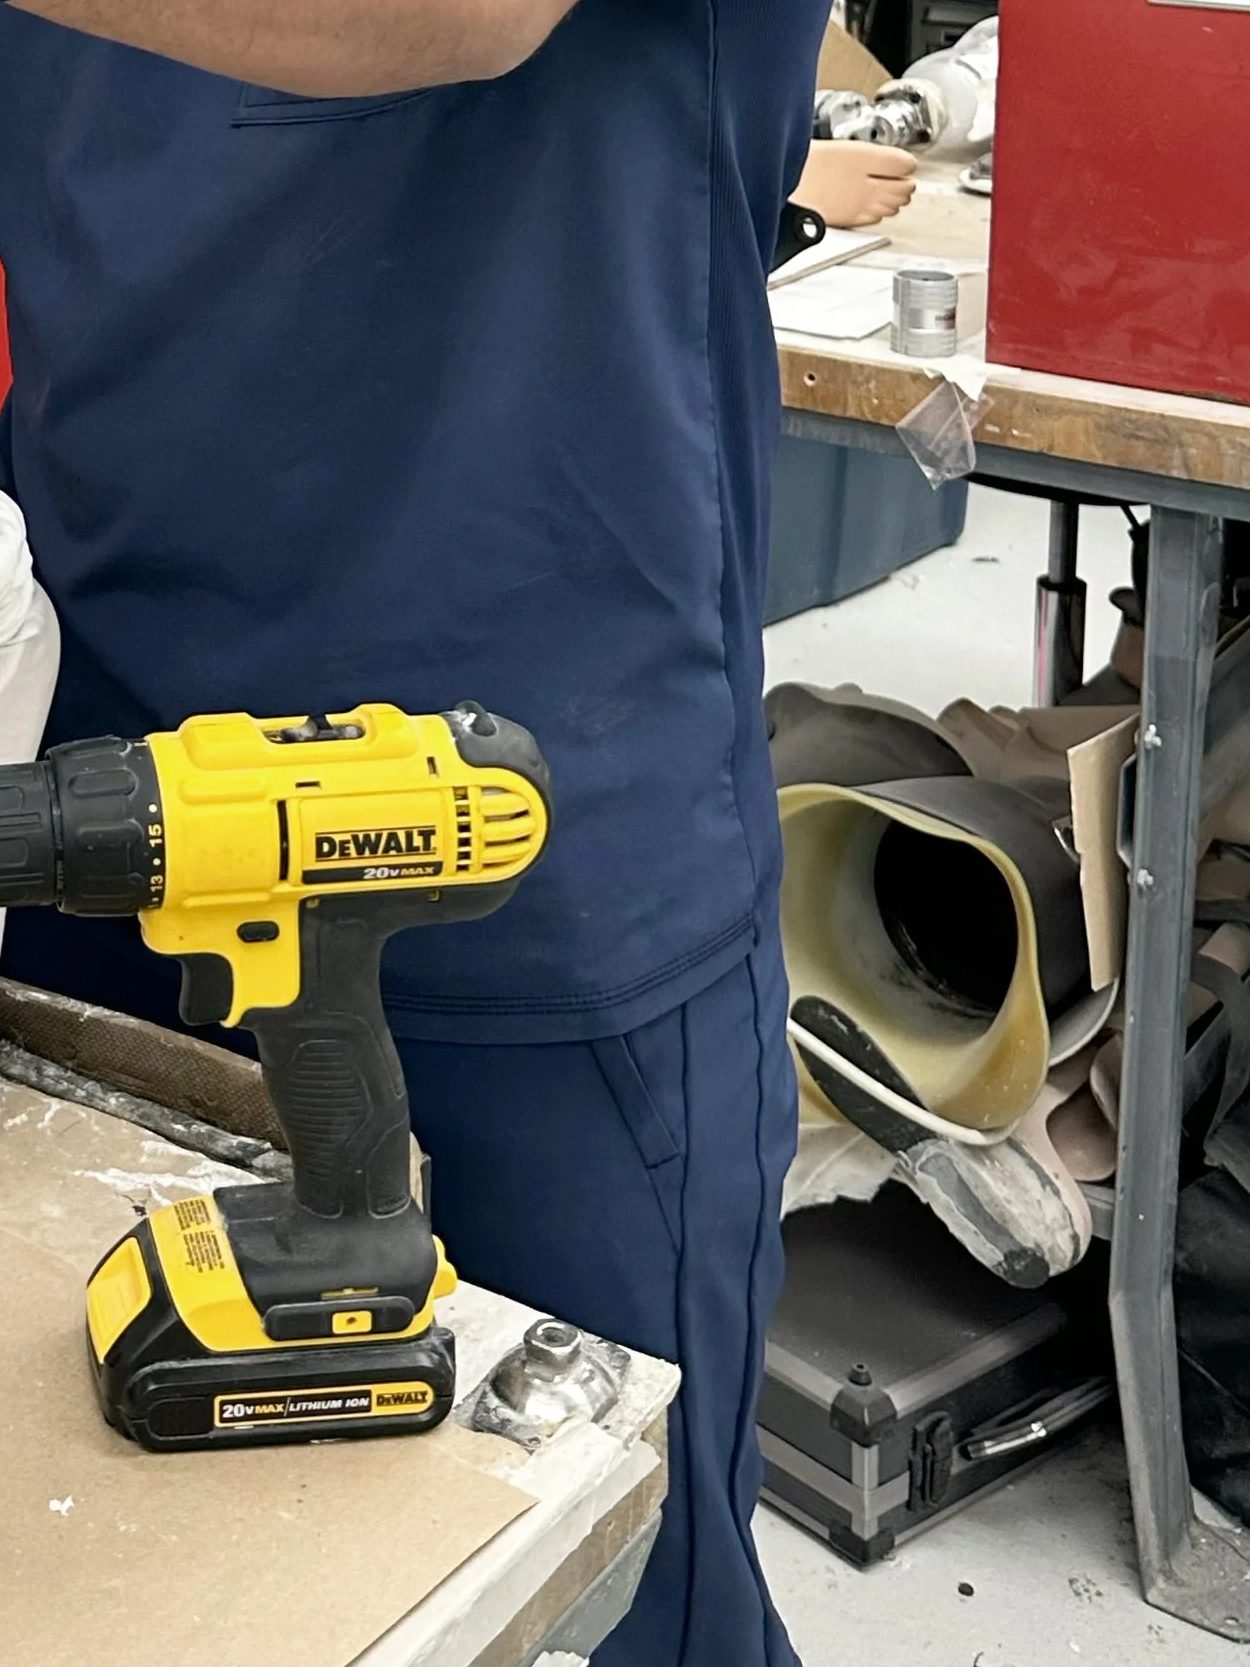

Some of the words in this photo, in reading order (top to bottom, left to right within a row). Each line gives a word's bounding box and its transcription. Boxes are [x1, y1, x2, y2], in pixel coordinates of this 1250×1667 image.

[148, 823, 162, 848] 15
[315, 829, 436, 859] DEWALT
[150, 874, 163, 892] 13
[345, 1397, 370, 1408] ION
[376, 1390, 429, 1407] DEWALT
